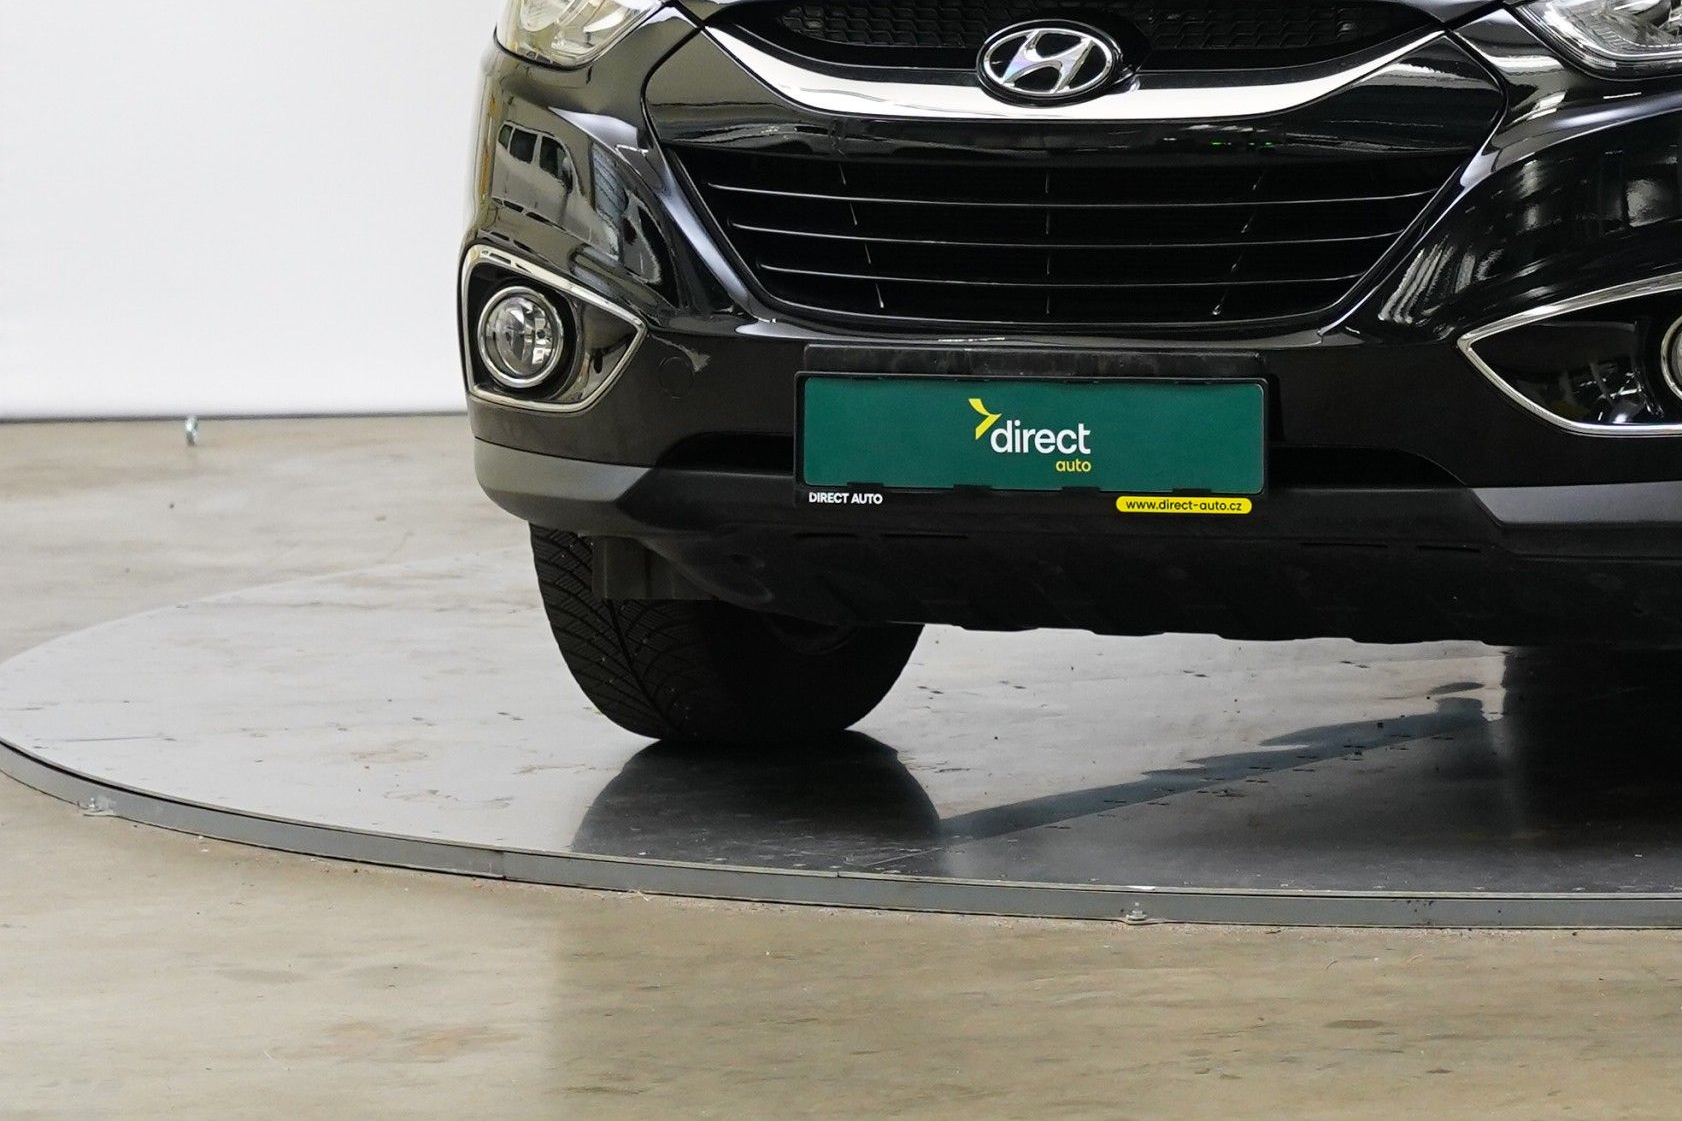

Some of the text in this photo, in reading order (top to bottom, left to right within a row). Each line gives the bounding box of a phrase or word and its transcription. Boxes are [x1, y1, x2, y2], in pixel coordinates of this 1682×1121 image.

[990, 420, 1091, 455] direct
[1056, 458, 1092, 472] auto
[808, 491, 883, 505] DIRECT AUTO
[1126, 499, 1242, 511] www.direct-auto.cz
